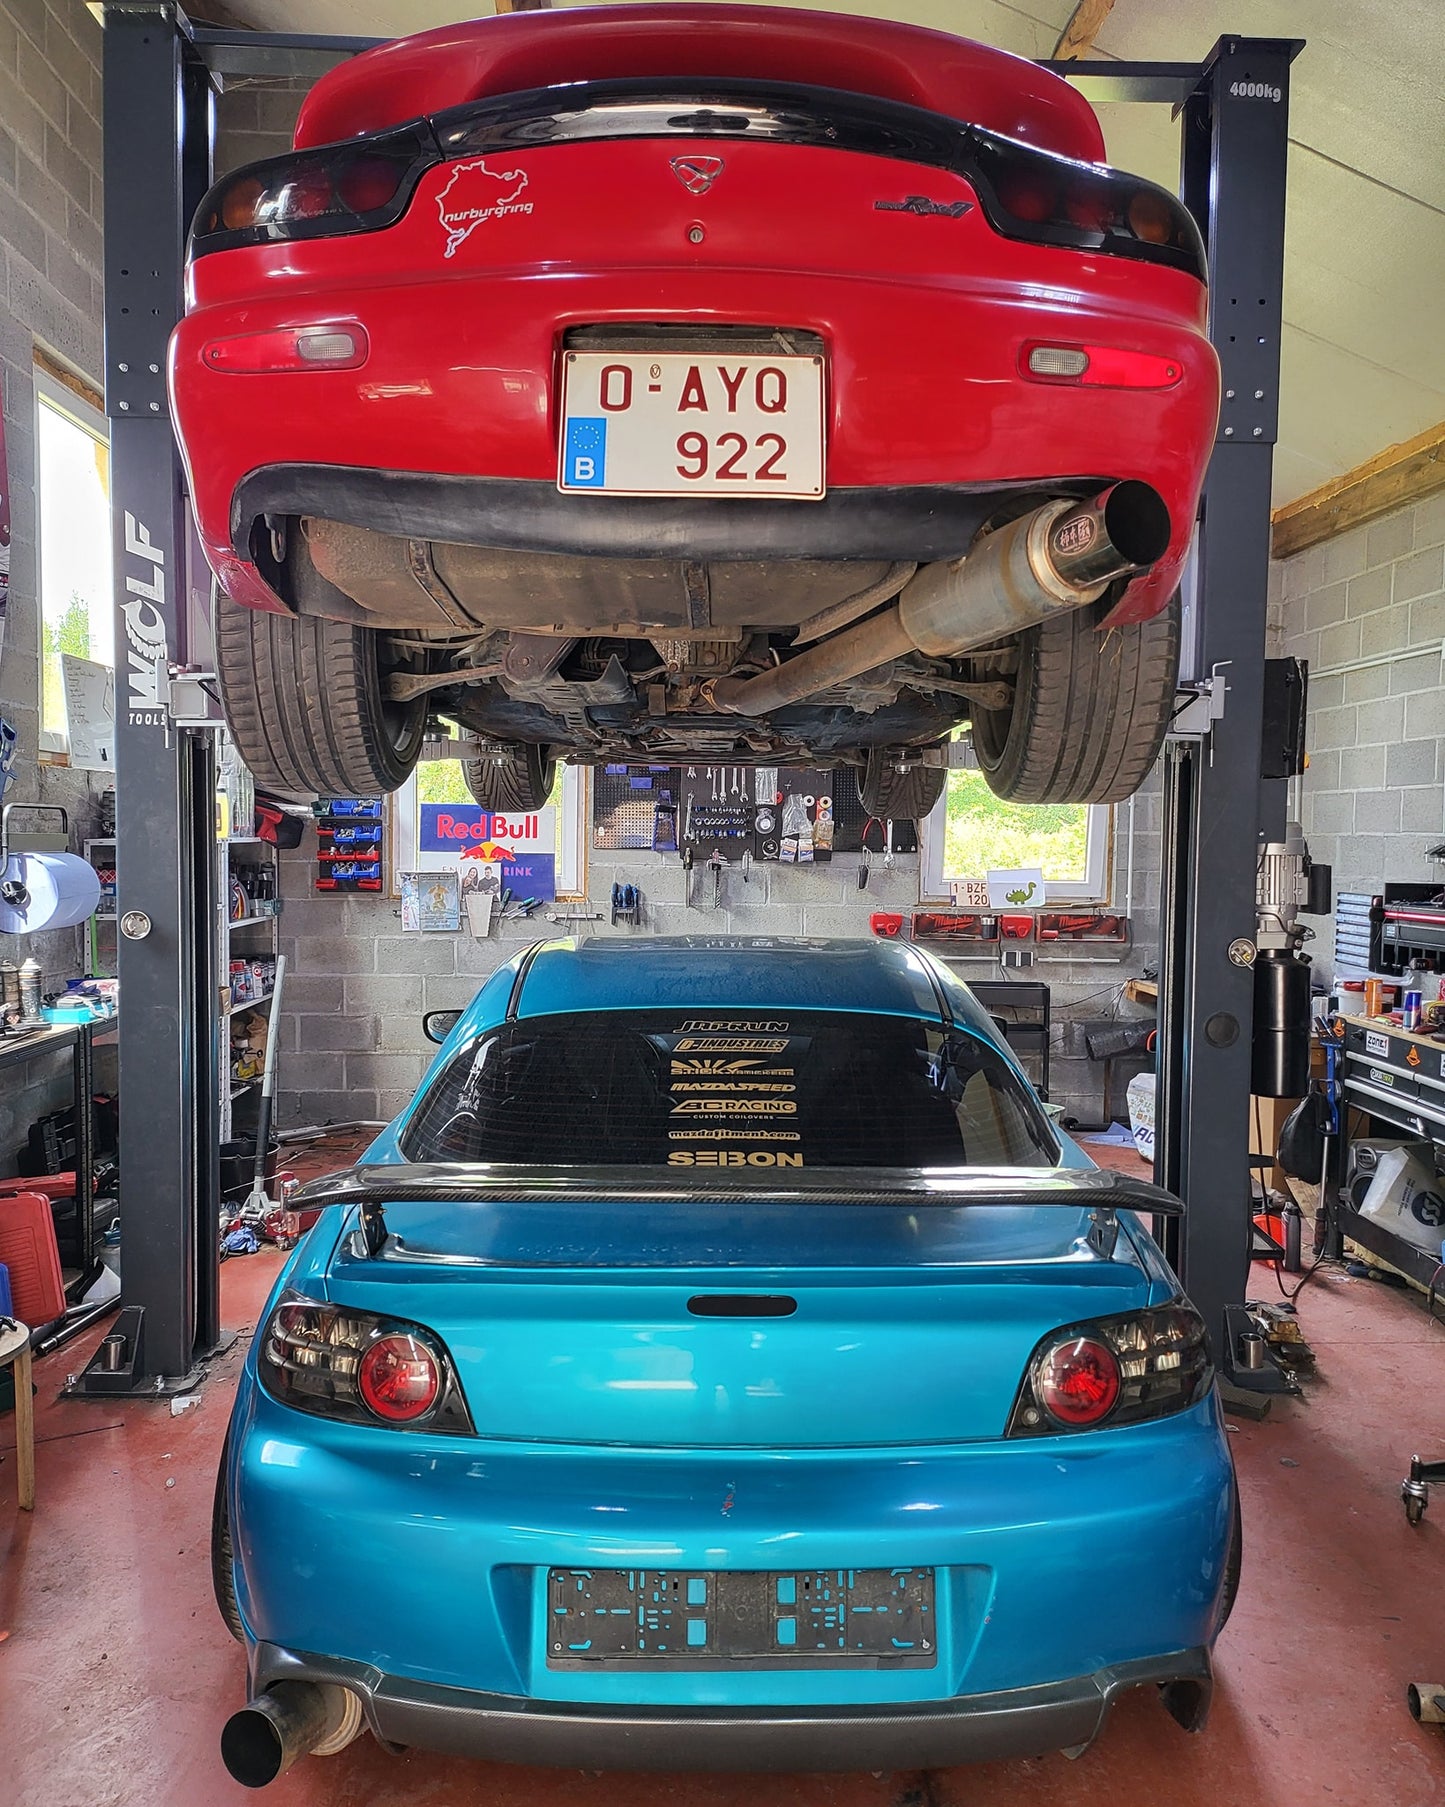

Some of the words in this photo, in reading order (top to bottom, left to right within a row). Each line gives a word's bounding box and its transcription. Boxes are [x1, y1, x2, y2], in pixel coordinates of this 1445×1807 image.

[1230, 82, 1281, 102] 4000kg
[444, 202, 534, 222] nurburgring
[676, 431, 787, 480] 922
[575, 457, 595, 480] B
[437, 814, 487, 839] Red
[490, 815, 539, 840] Bull
[503, 866, 534, 877] RINK
[968, 894, 988, 905] 120
[670, 1082, 797, 1092] MAZDASPEED
[669, 1129, 799, 1140] mazdafitment.com
